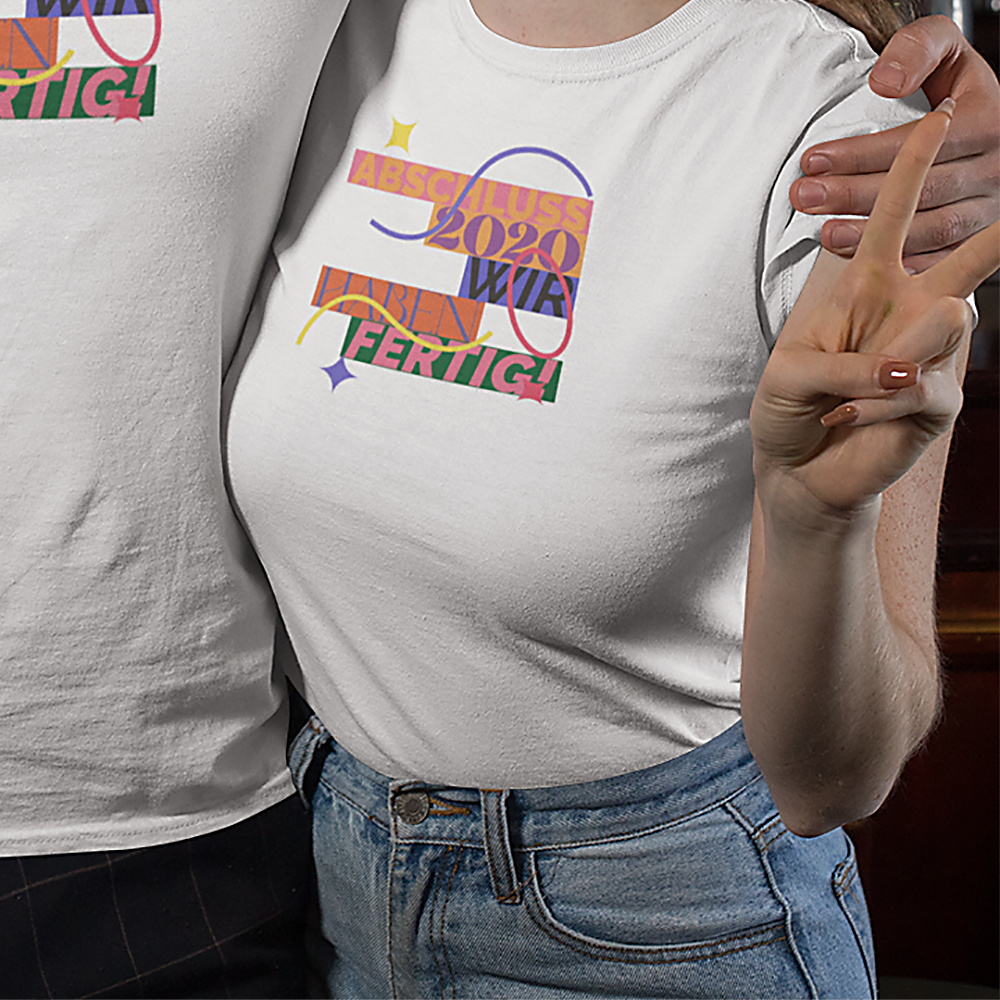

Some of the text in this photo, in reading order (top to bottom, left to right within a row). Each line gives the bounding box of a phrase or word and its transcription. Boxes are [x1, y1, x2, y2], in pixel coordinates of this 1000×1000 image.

[351, 152, 587, 230] ABSCHLUSS
[427, 206, 581, 274] 2020
[318, 266, 482, 342] HABEN
[468, 256, 574, 317] WIR
[344, 320, 557, 398] FERTIG!
